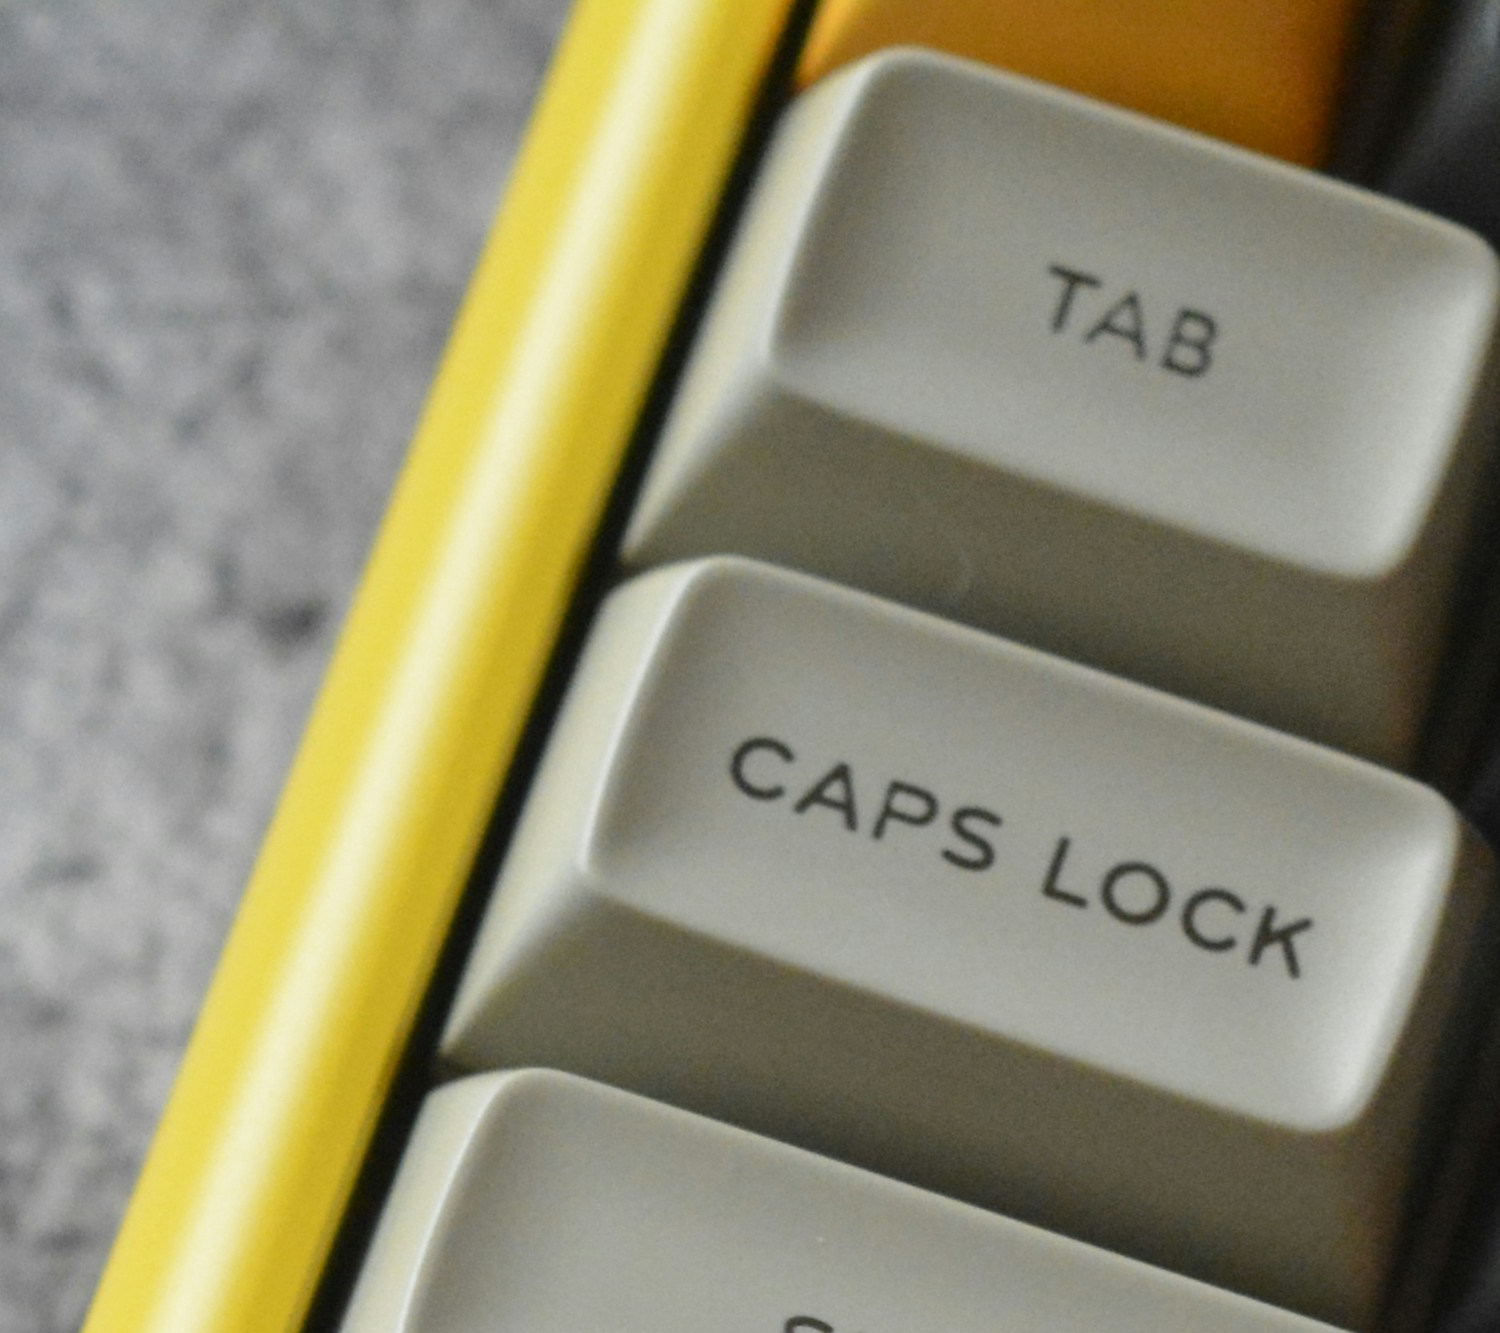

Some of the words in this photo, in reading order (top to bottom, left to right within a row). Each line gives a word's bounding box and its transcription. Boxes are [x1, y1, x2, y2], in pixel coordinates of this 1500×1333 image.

[1045, 264, 1220, 380] TAB
[726, 735, 1004, 874] CAPS
[1040, 835, 1314, 980] LOCK
